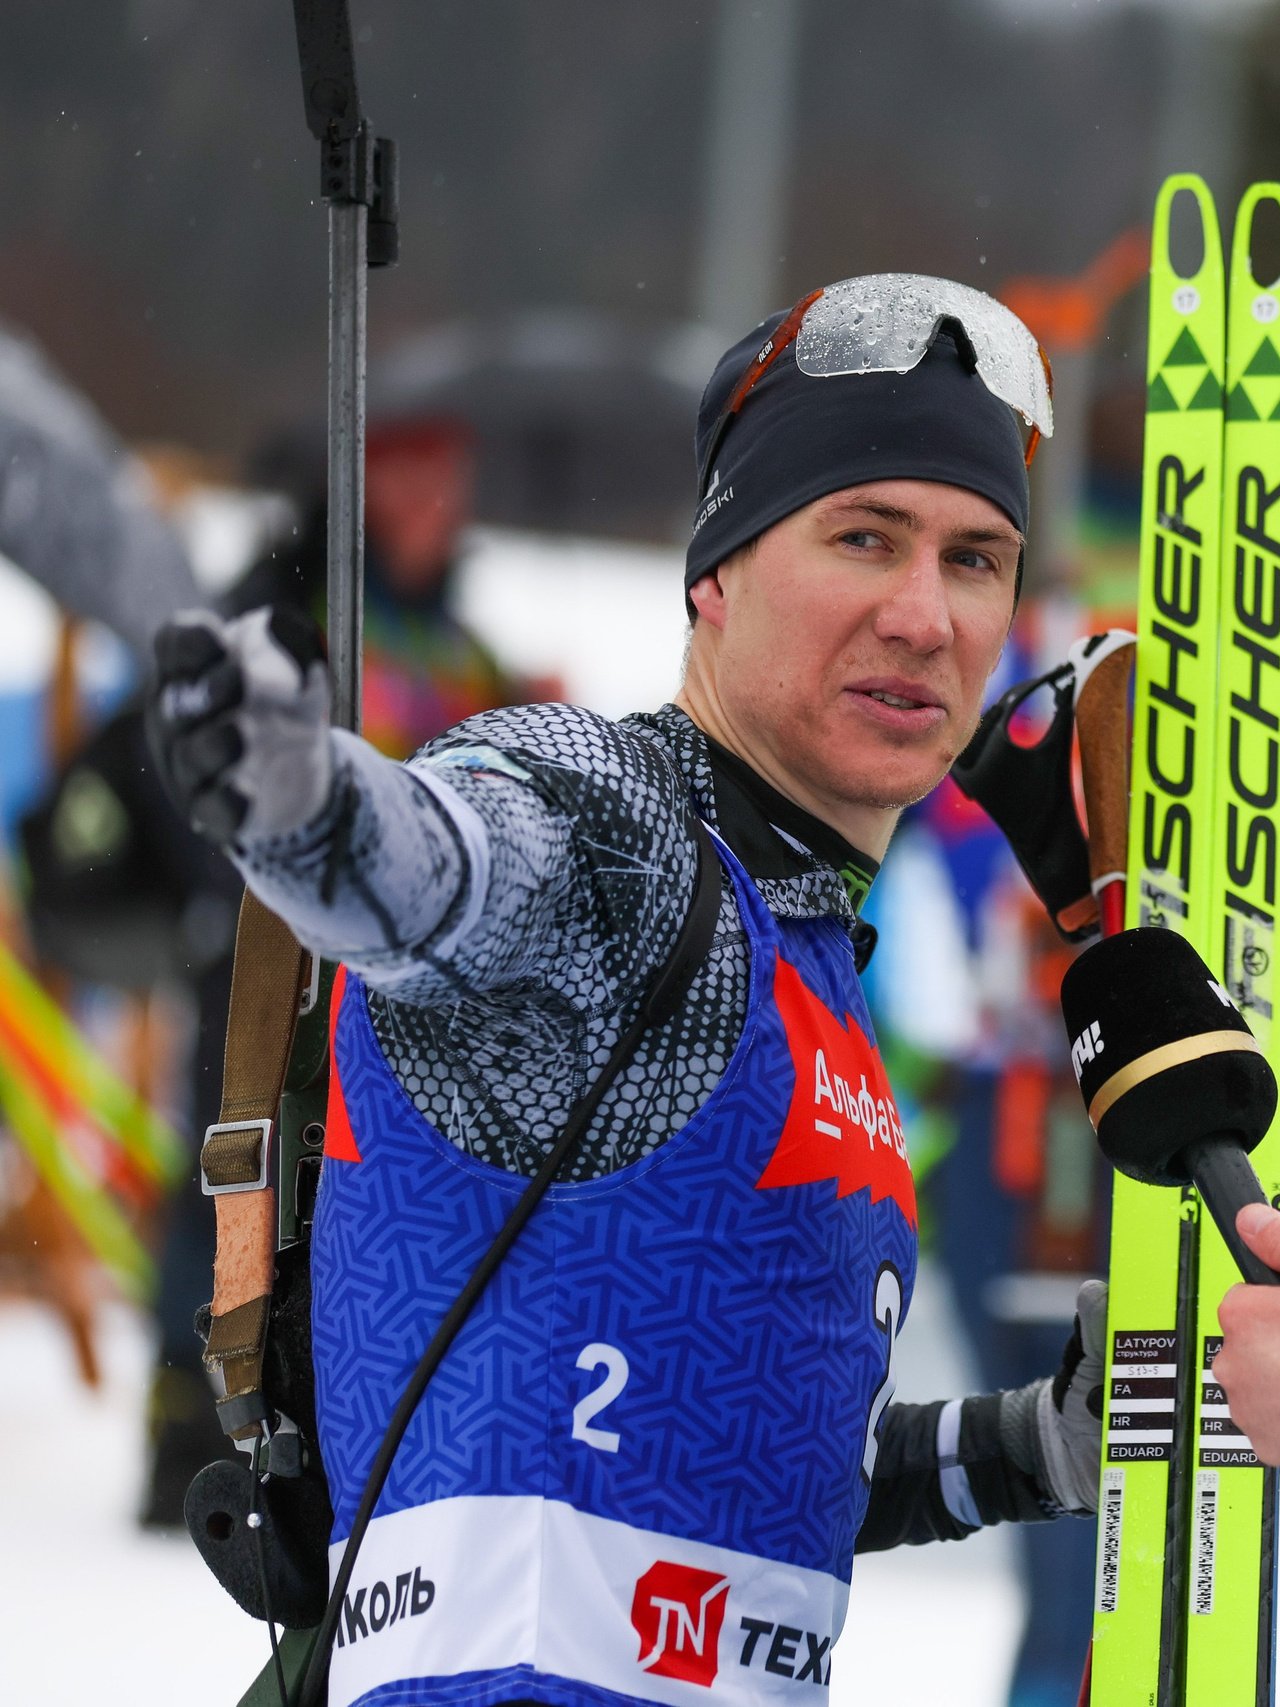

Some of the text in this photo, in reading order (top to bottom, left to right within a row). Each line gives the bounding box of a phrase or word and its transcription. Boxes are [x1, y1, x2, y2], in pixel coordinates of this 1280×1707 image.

[1141, 454, 1206, 927] ISCHER
[1115, 1337, 1177, 1349] LATYPOV
[1114, 1350, 1159, 1359] структура
[1113, 1384, 1132, 1395] FA
[1205, 1389, 1224, 1400] FA
[572, 1342, 630, 1453] 2
[1112, 1416, 1131, 1426] HR
[1203, 1421, 1223, 1432] HR
[1110, 1446, 1165, 1458] EDUARD
[1202, 1452, 1258, 1464] EDUARD
[740, 1616, 832, 1687] ТЕХ
